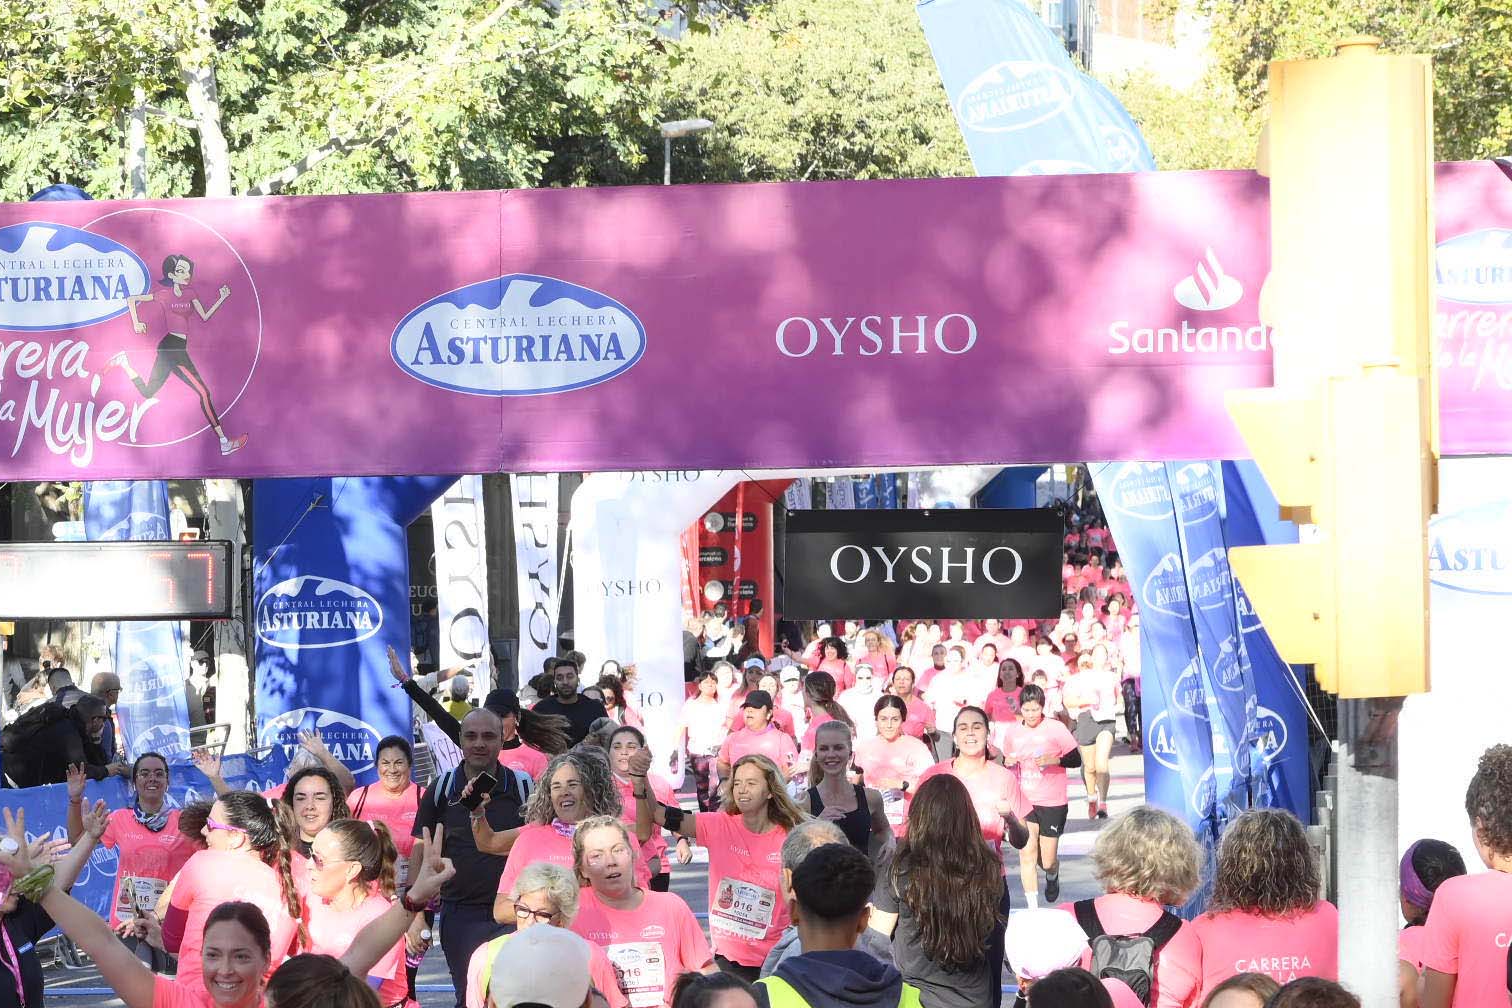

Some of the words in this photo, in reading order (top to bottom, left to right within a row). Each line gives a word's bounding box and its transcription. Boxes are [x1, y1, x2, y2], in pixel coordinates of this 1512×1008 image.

[52, 257, 126, 270] LECHERA
[449, 316, 526, 331] CENTRAL
[536, 313, 618, 327] LECHERA
[411, 321, 627, 368] ASTURIANA
[776, 313, 978, 358] OYSHO
[11, 374, 159, 468] Mujer
[829, 543, 1024, 586] OYSHO
[273, 600, 315, 610] CENTRAL
[320, 600, 369, 608] LECHERA
[260, 604, 374, 633] ASTURIANA
[320, 731, 370, 740] LECHERA
[733, 900, 753, 912] 016
[1235, 955, 1312, 974] CARRERA
